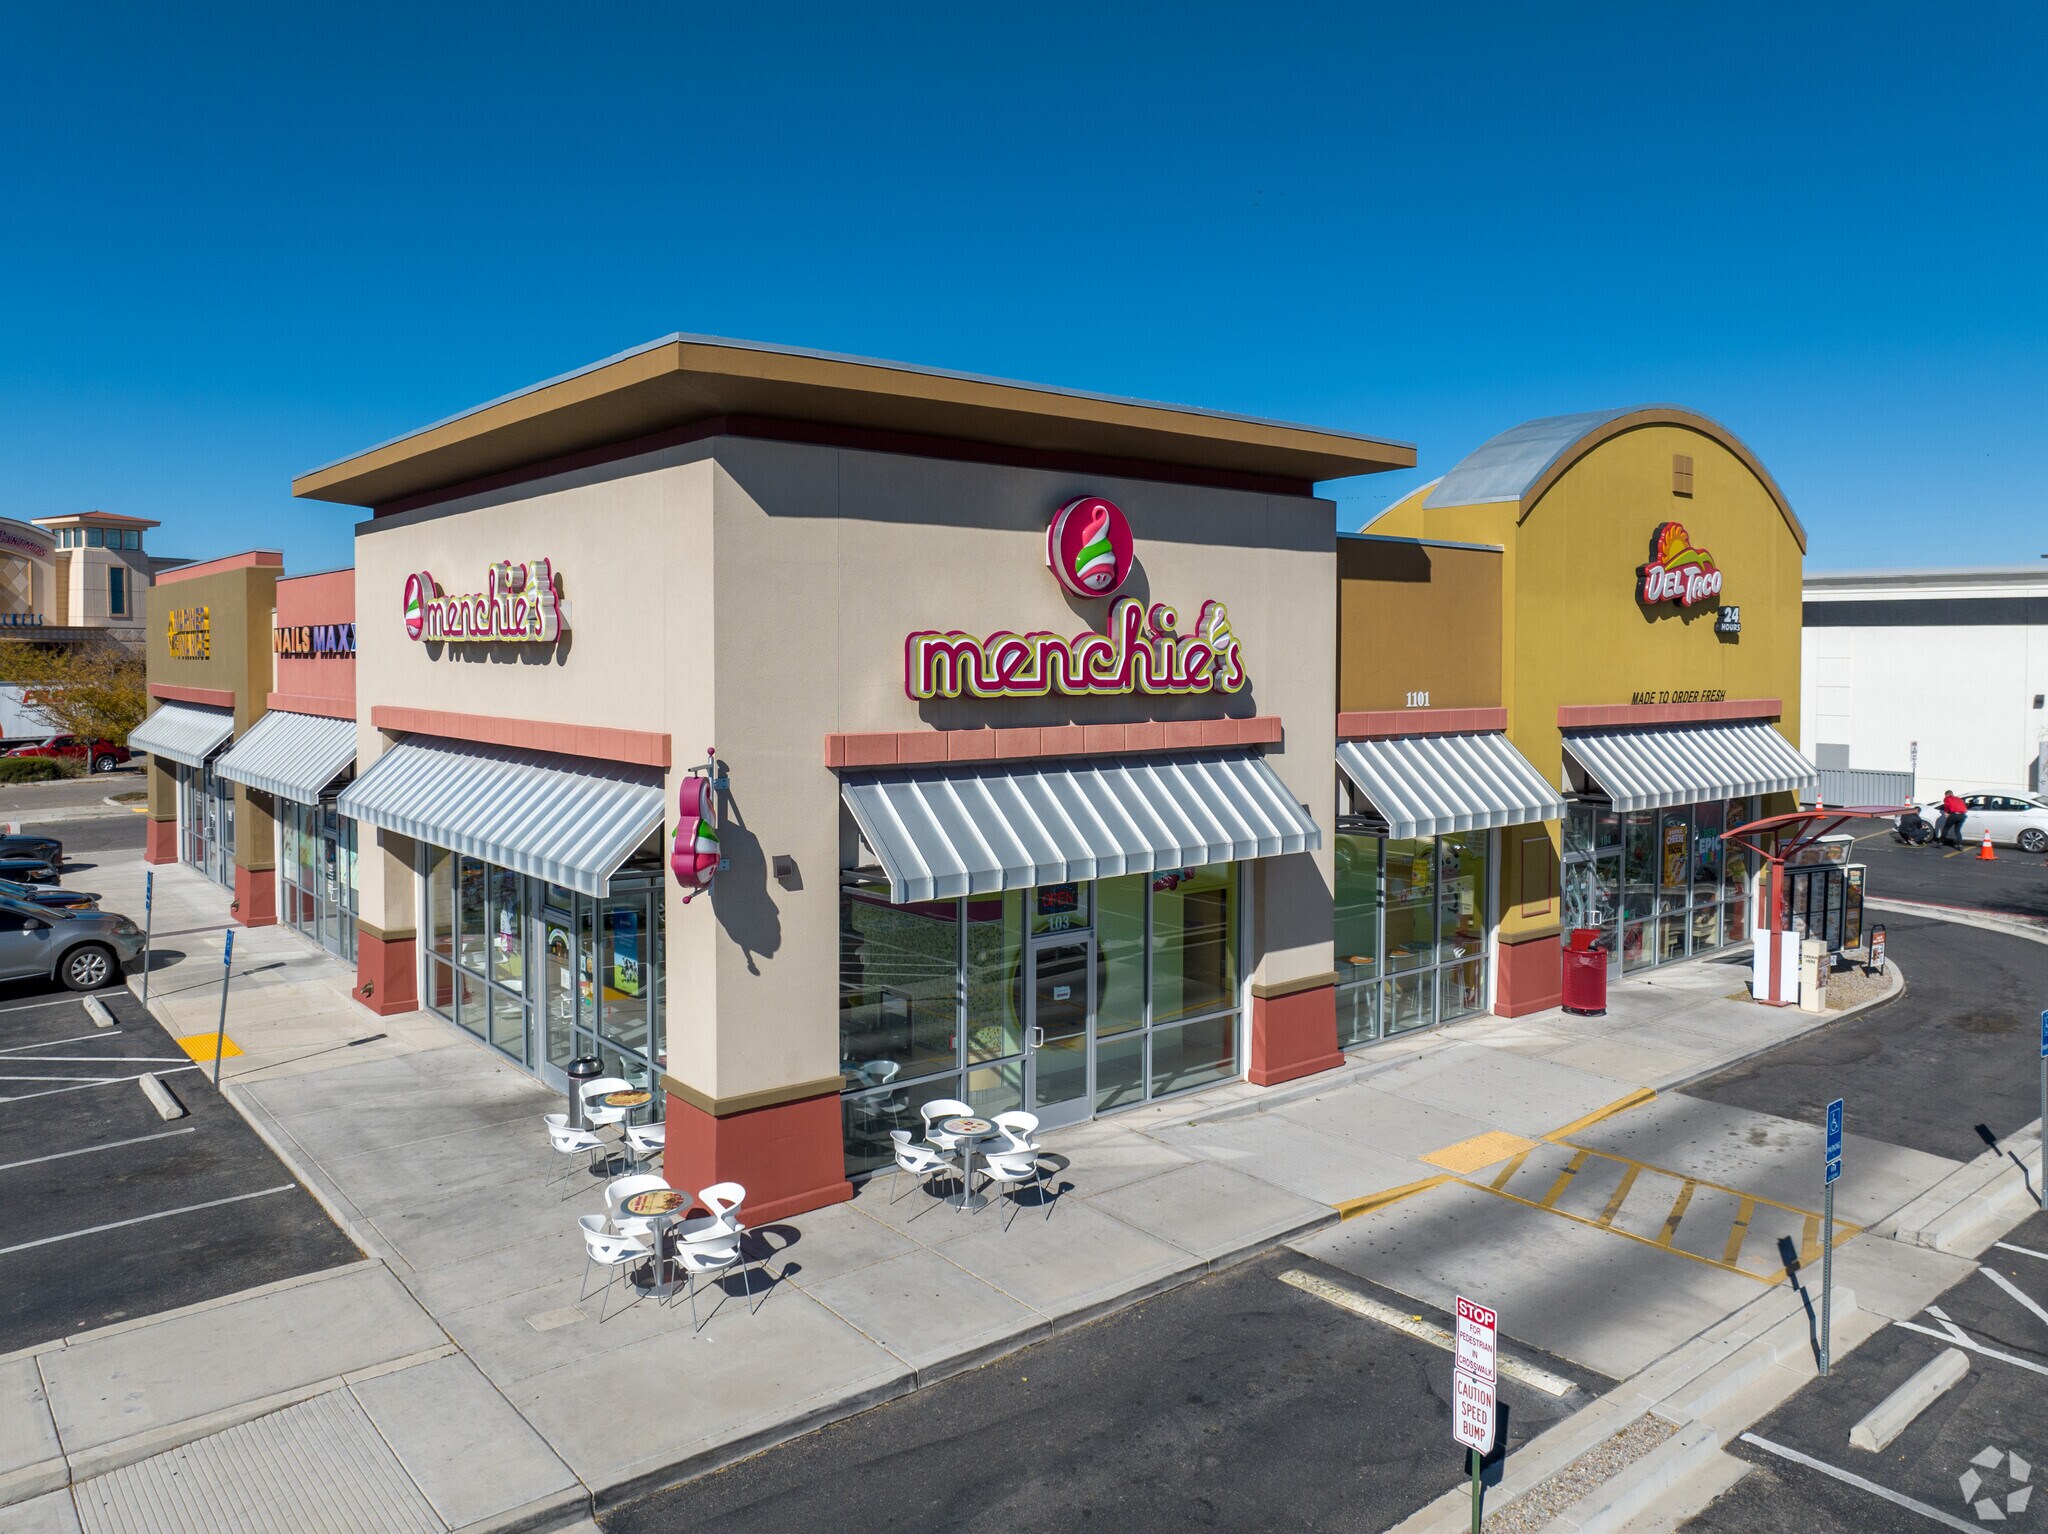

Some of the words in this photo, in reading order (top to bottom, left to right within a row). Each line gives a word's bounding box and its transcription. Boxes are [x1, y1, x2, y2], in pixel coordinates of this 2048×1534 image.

[427, 559, 557, 643] menchie's
[1723, 606, 1740, 623] 24
[1721, 622, 1741, 632] HOURS
[909, 597, 1246, 699] menchie's
[1406, 691, 1430, 706] 1101
[1631, 691, 1657, 705] MADE
[1658, 691, 1671, 704] TO
[1671, 690, 1699, 704] ORDER
[1699, 689, 1726, 703] FRESH
[1699, 835, 1721, 854] EPIC
[1042, 891, 1073, 907] OPEN
[1048, 916, 1069, 932] 103
[1459, 1300, 1494, 1326] STOP
[1470, 1324, 1481, 1335] FOR
[1459, 1330, 1493, 1353] PEDESTRIAN
[1472, 1350, 1477, 1358] IN
[1458, 1355, 1493, 1377] CROSSWALK
[1457, 1380, 1492, 1408] CAUTION
[1461, 1401, 1488, 1425] SPEED
[1462, 1420, 1486, 1442] BUMP
